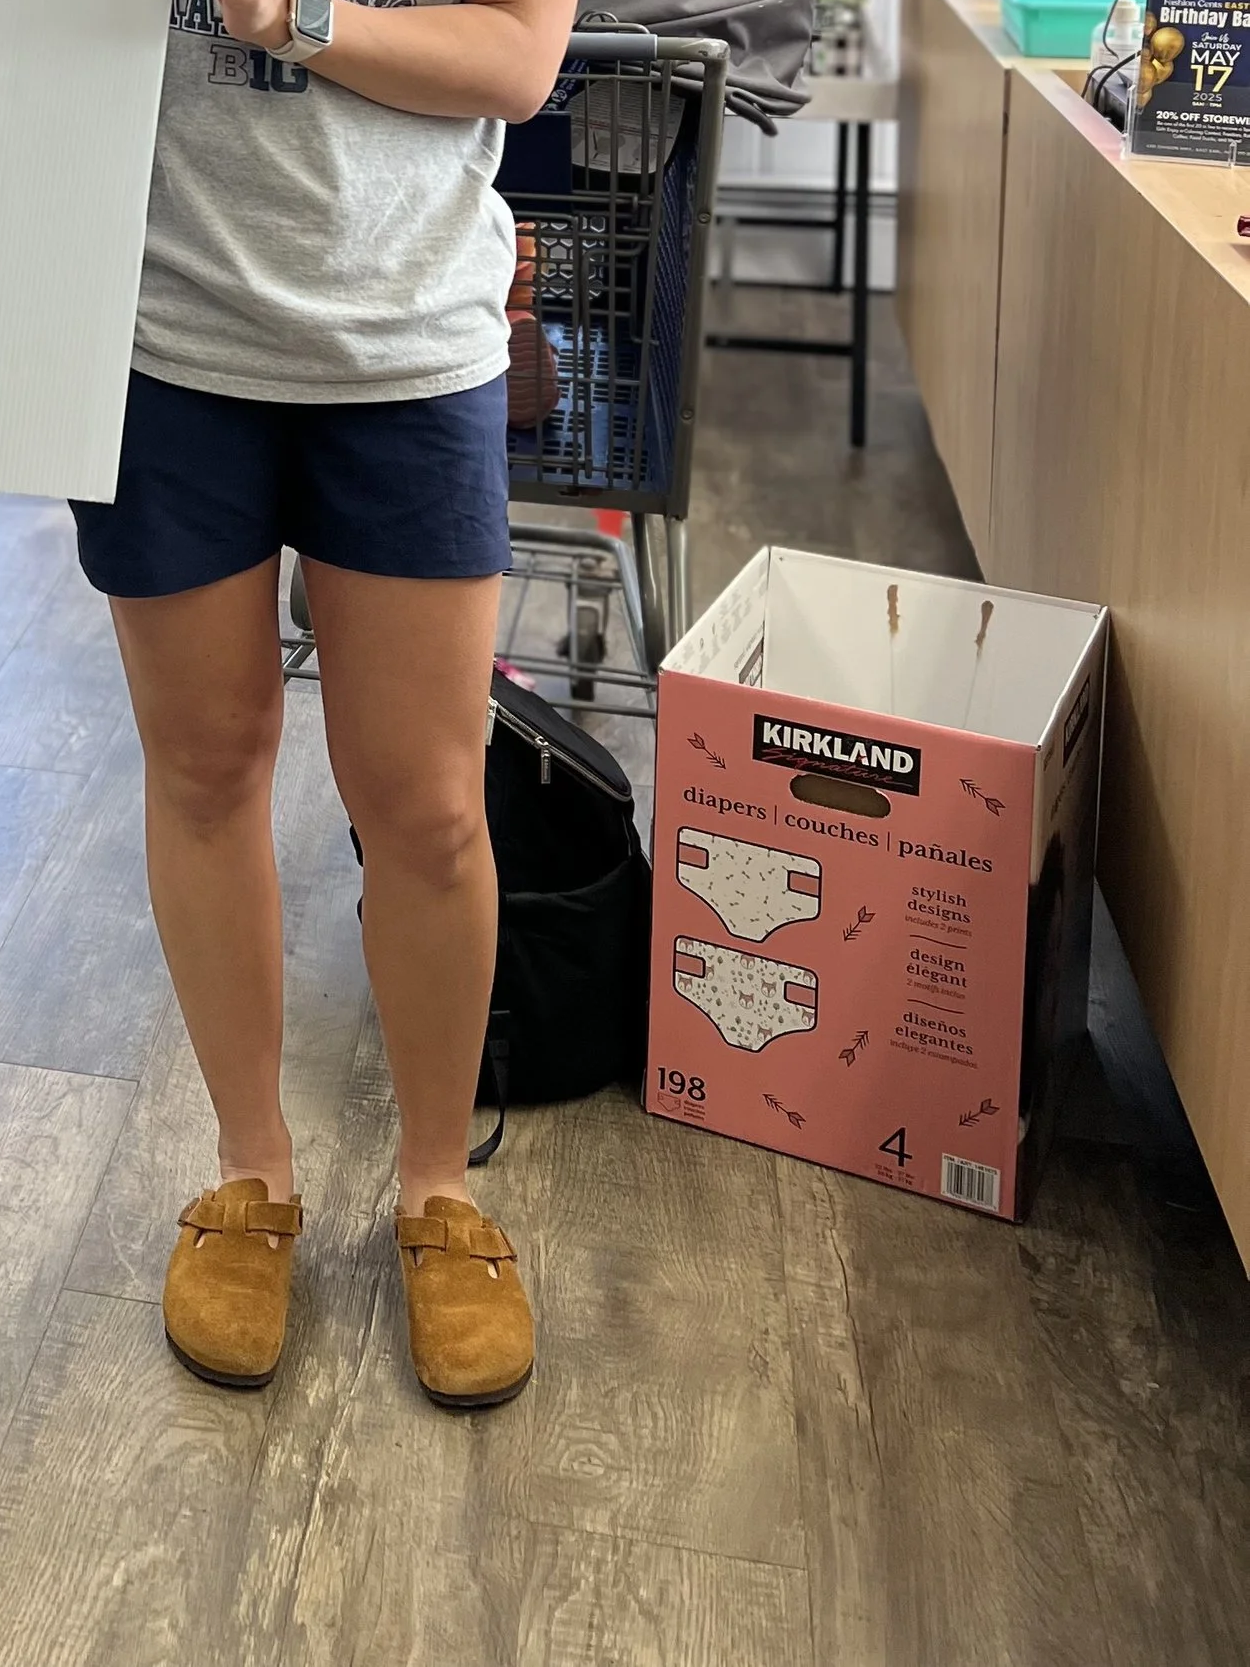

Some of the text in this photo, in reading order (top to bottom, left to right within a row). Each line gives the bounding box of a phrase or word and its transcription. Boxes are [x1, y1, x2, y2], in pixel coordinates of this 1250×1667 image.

[1159, 6, 1228, 28] Birthday
[1224, 1, 1250, 10] EAST
[1190, 49, 1240, 66] MAY
[1192, 41, 1242, 51] SATURDAY
[1190, 64, 1234, 93] 17
[1192, 92, 1223, 102] 2025
[1156, 110, 1179, 121] 20%
[1180, 112, 1200, 122] OFF
[763, 721, 914, 774] KIRKLAND
[761, 747, 914, 788] Signature
[683, 786, 993, 873] diapers couches pañales
[911, 885, 967, 908] stylish
[905, 914, 939, 930] includes
[907, 899, 971, 924] designs
[910, 948, 965, 973] design
[906, 962, 968, 989] élégant
[903, 1011, 967, 1038] diseños
[895, 1025, 974, 1055] elegantes
[657, 1067, 706, 1101] 198
[878, 1127, 913, 1167] 4
